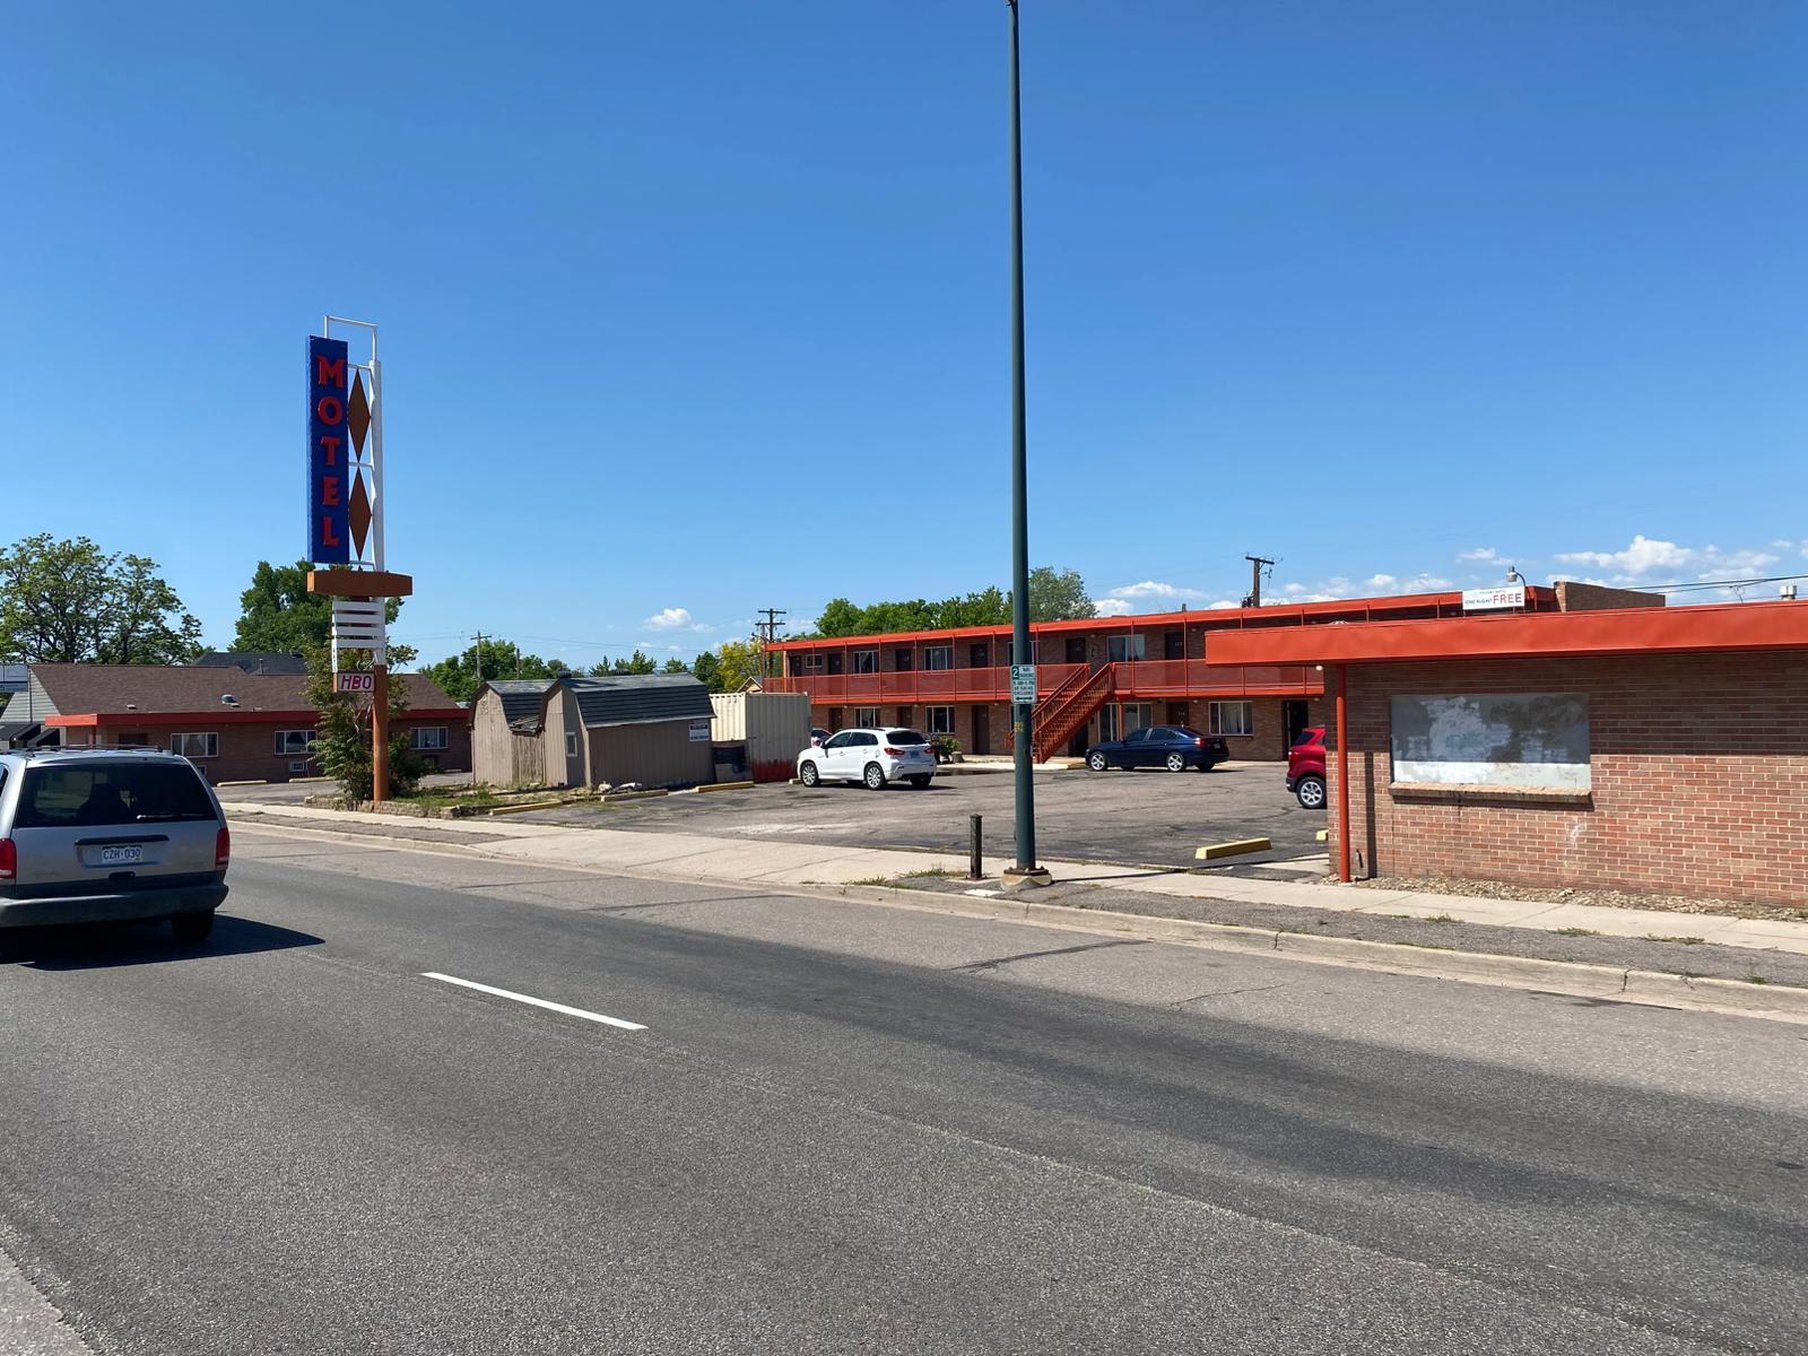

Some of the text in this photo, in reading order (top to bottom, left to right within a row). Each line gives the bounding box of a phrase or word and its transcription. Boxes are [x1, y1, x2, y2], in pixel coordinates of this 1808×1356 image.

[317, 355, 345, 547] MOTEL
[1493, 592, 1522, 605] FREE
[1012, 667, 1019, 679] 2
[341, 674, 372, 690] HBO
